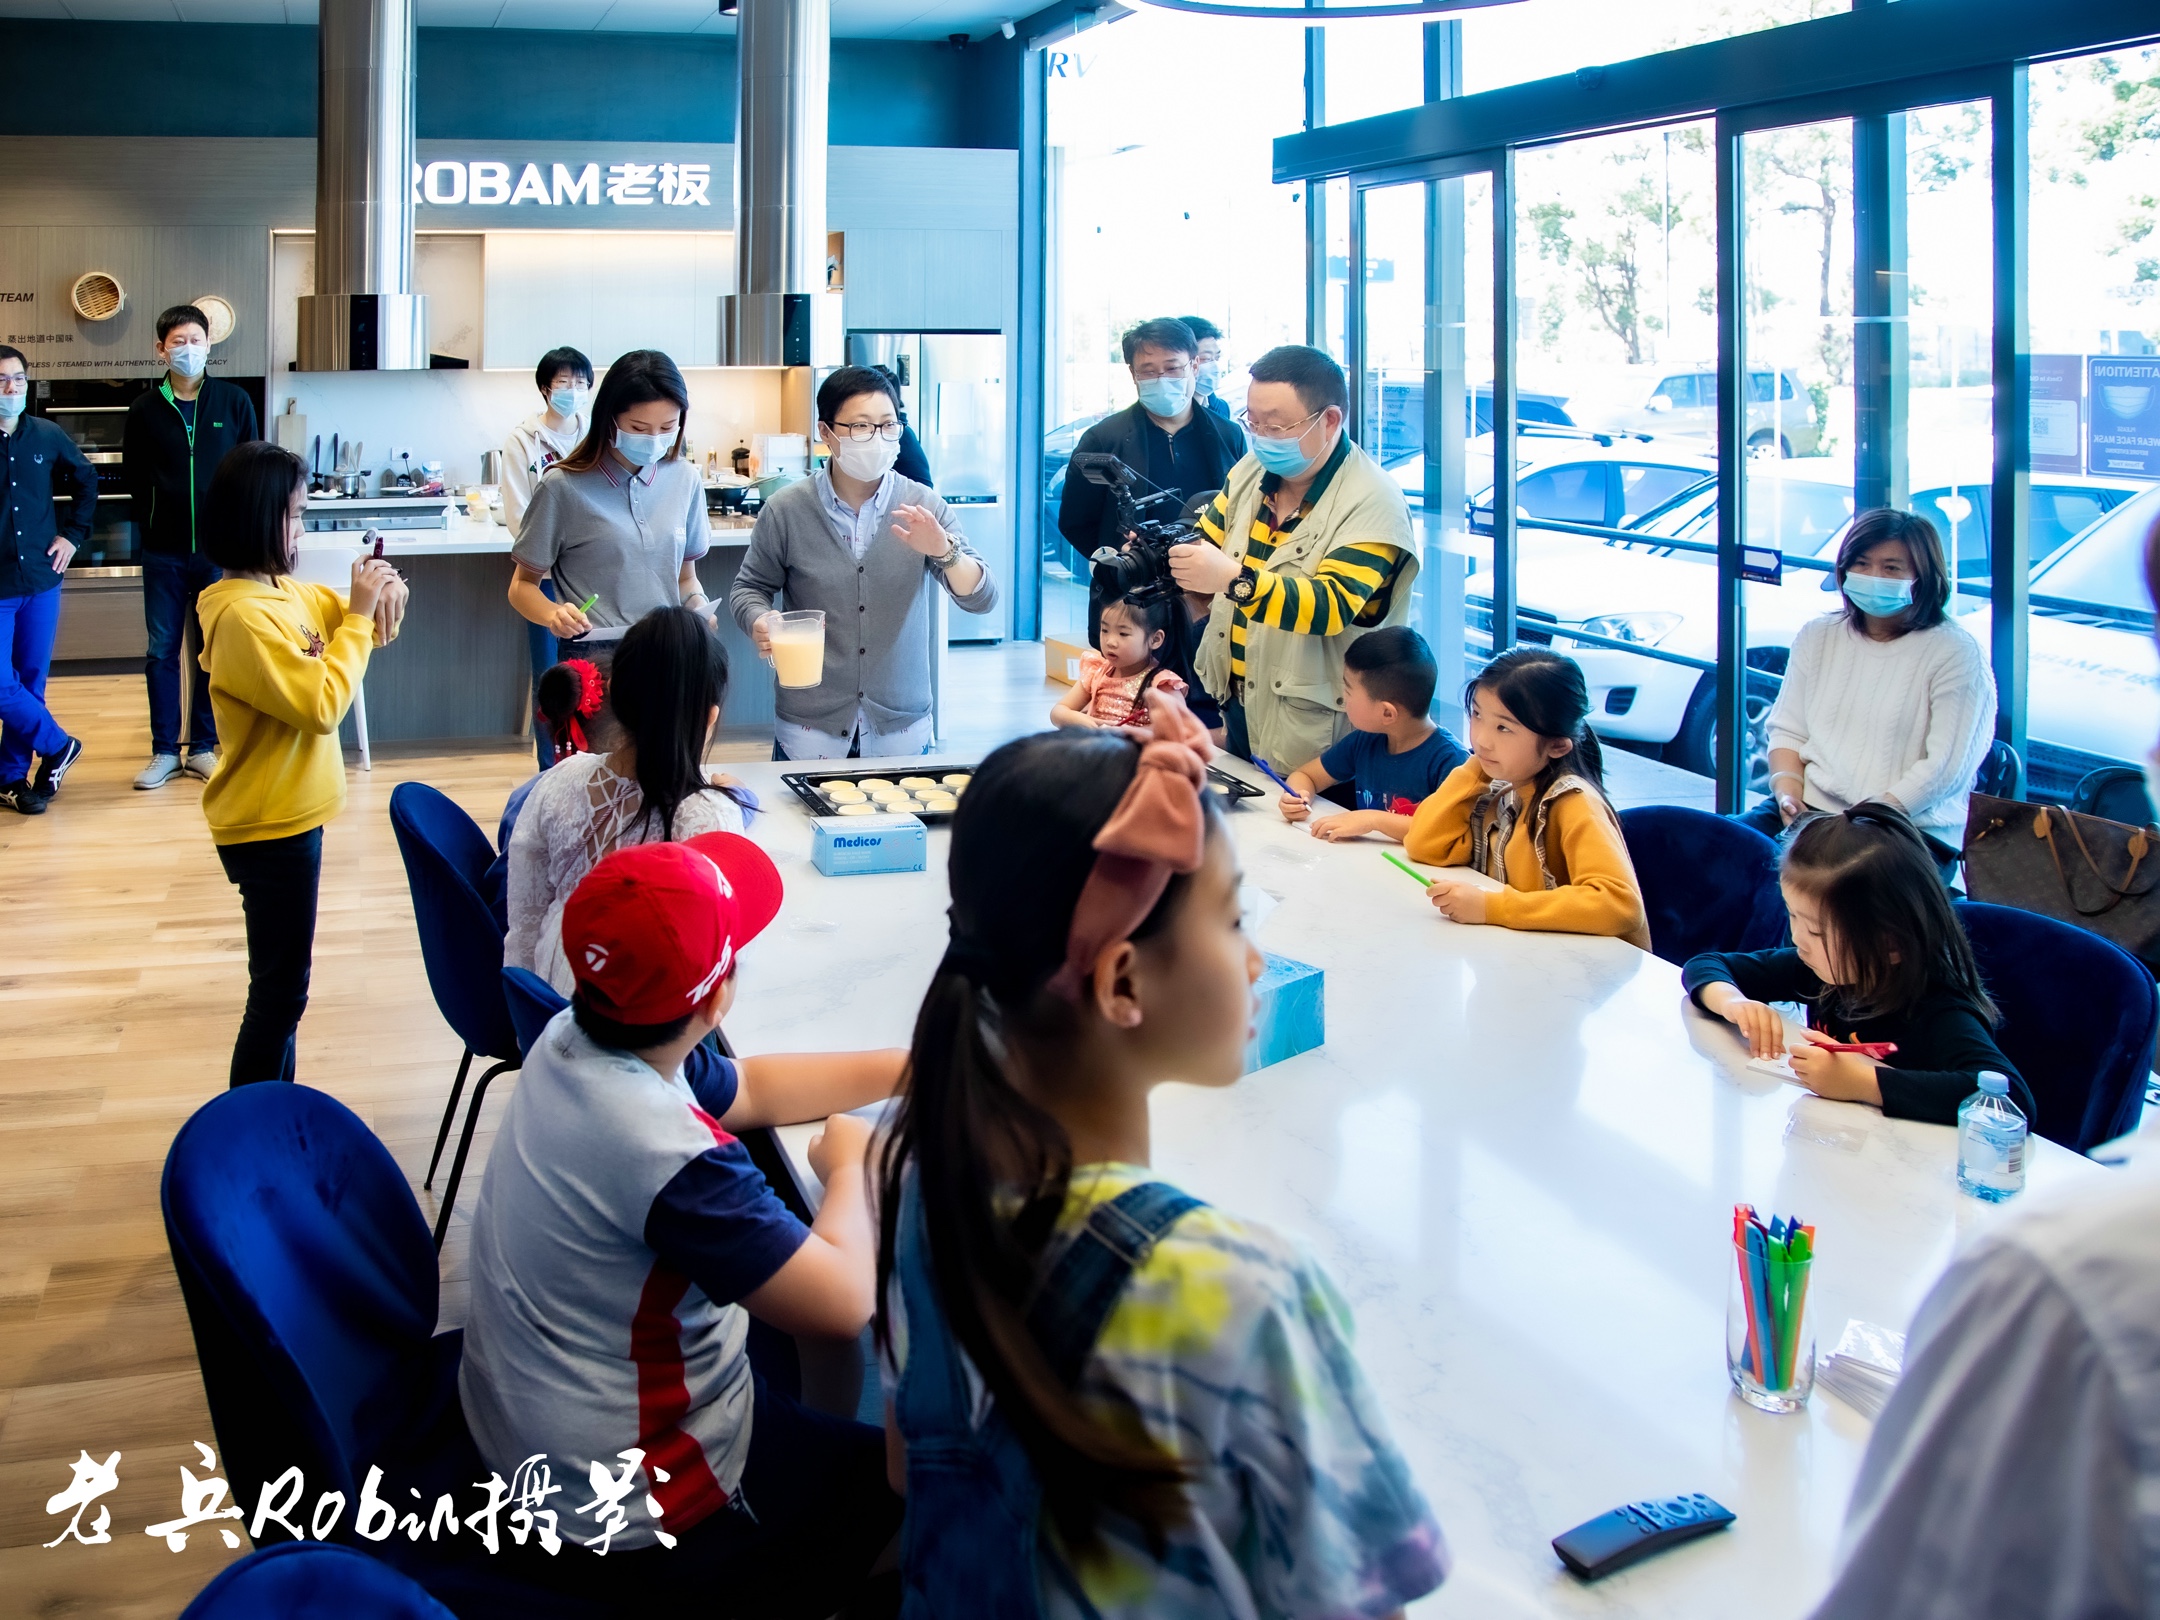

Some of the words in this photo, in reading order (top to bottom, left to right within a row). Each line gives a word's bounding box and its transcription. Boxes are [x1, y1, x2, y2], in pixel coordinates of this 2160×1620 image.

[413, 161, 600, 205] OBAM
[606, 163, 711, 205] 老板
[8, 334, 74, 344] 蒸出地道中国味
[57, 360, 92, 368] STEAMED
[114, 359, 156, 367] AUTHENTIC
[833, 836, 882, 848] Medicos
